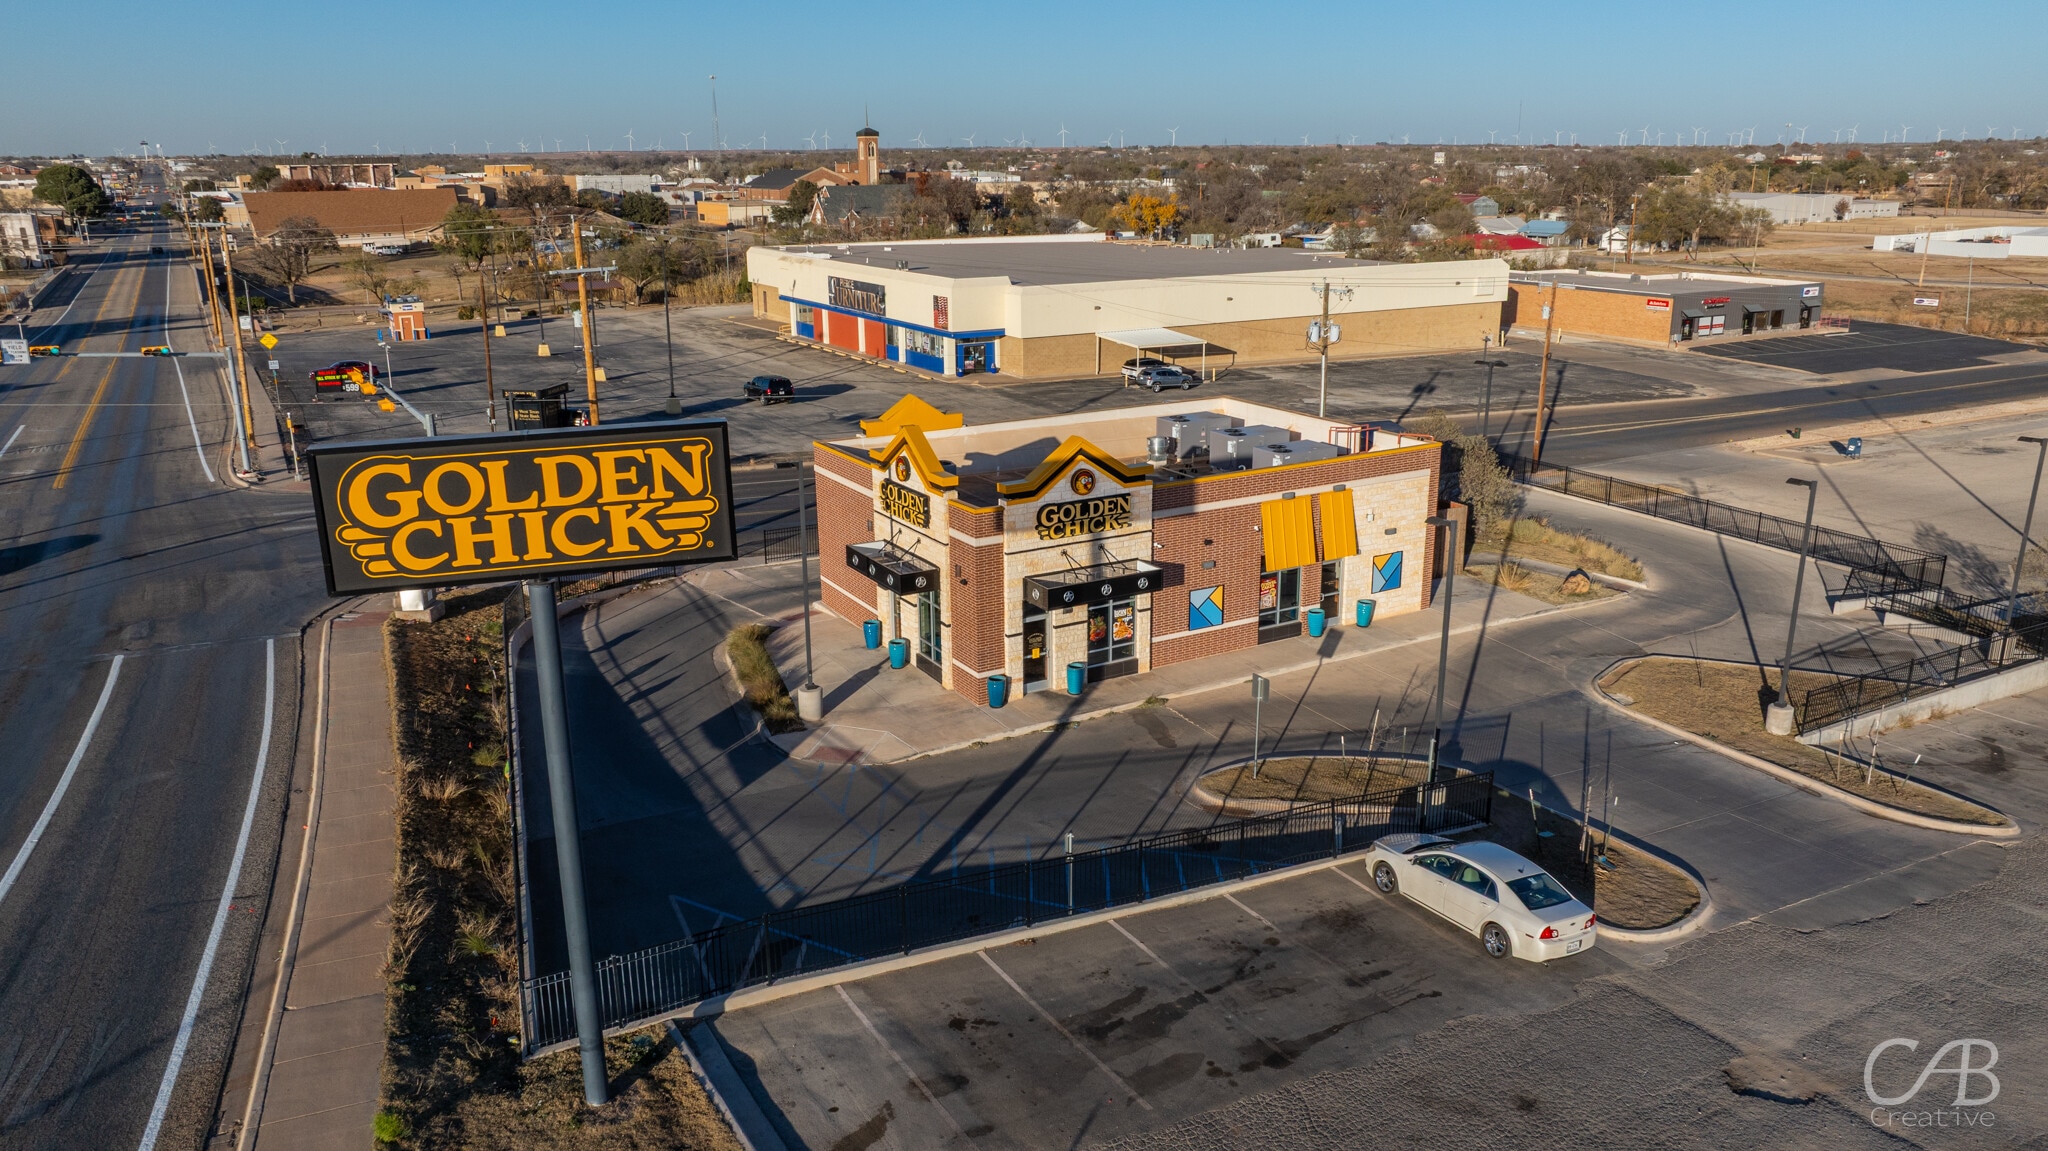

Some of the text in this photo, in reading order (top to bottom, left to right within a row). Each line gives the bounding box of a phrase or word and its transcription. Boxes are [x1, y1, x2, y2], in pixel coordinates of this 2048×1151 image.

[829, 278, 884, 314] FURNITURE
[348, 444, 706, 529] GOLDEN
[880, 480, 924, 513] GOLDEN
[884, 499, 920, 527] CHICK
[1040, 495, 1132, 527] GOLDEN
[1049, 513, 1121, 540] CHICK
[391, 501, 675, 571] CHICK
